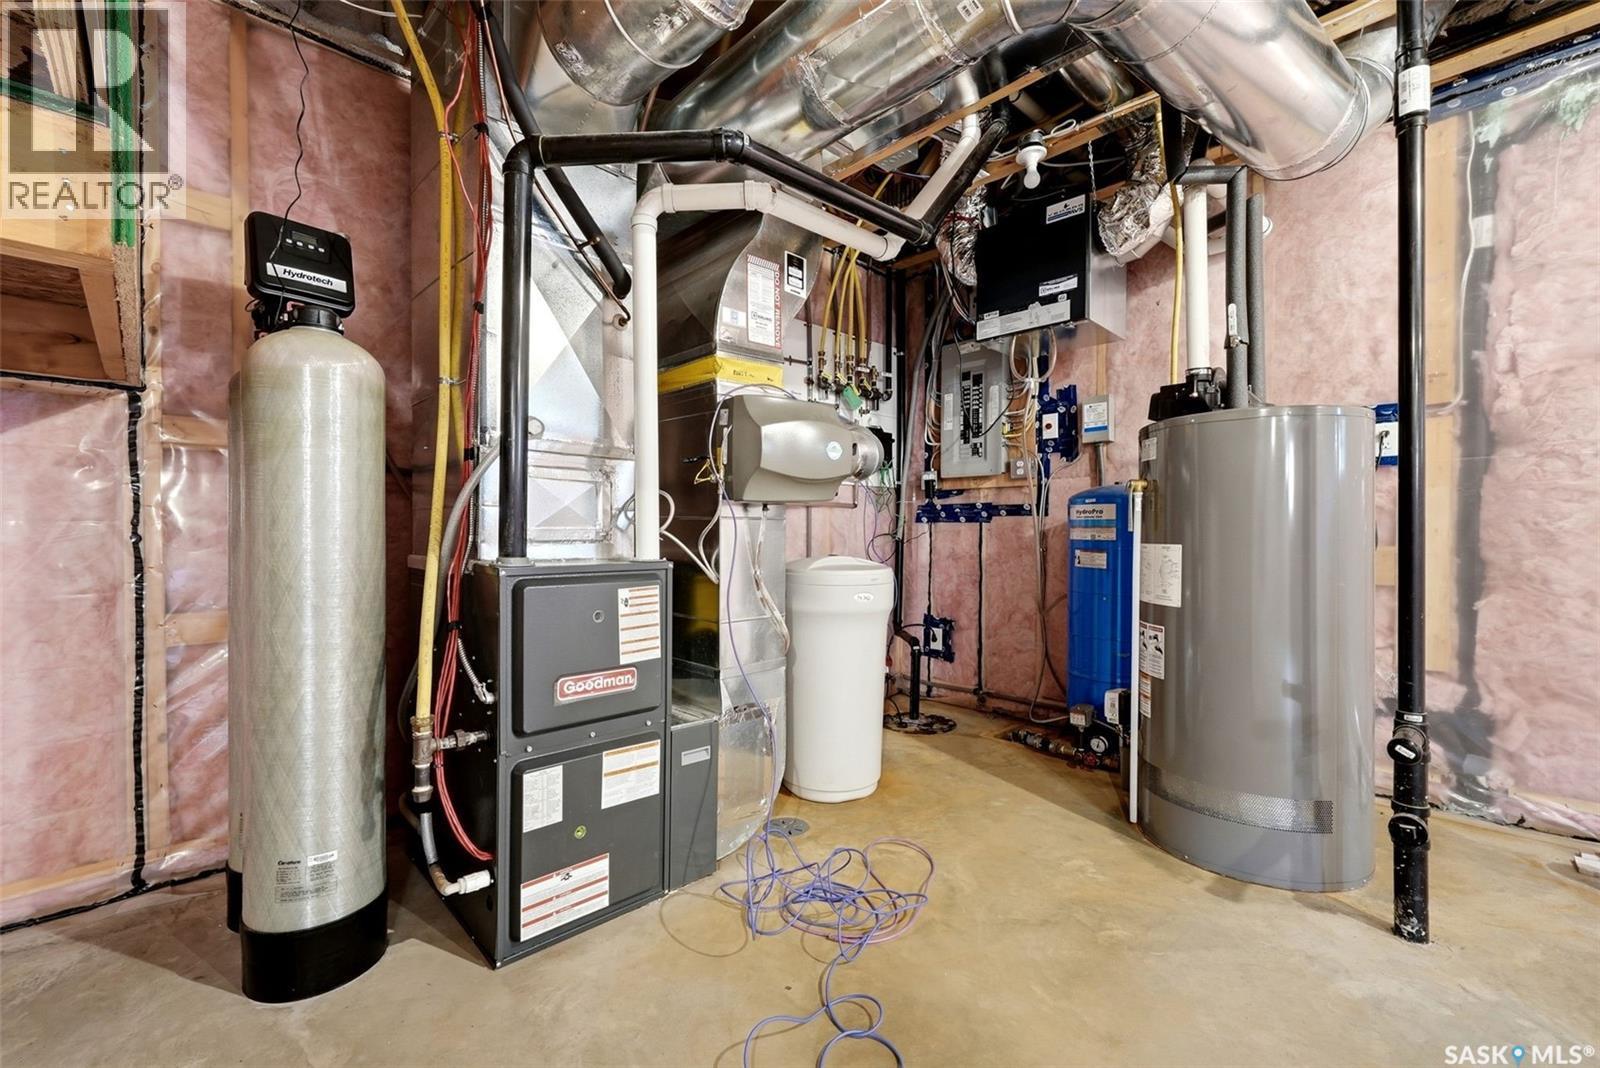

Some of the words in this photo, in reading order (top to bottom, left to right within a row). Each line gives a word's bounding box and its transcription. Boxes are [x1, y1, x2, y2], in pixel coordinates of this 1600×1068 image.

[282, 268, 334, 287] Hydrotech
[774, 272, 780, 286] DO
[563, 673, 634, 694] Goodman
